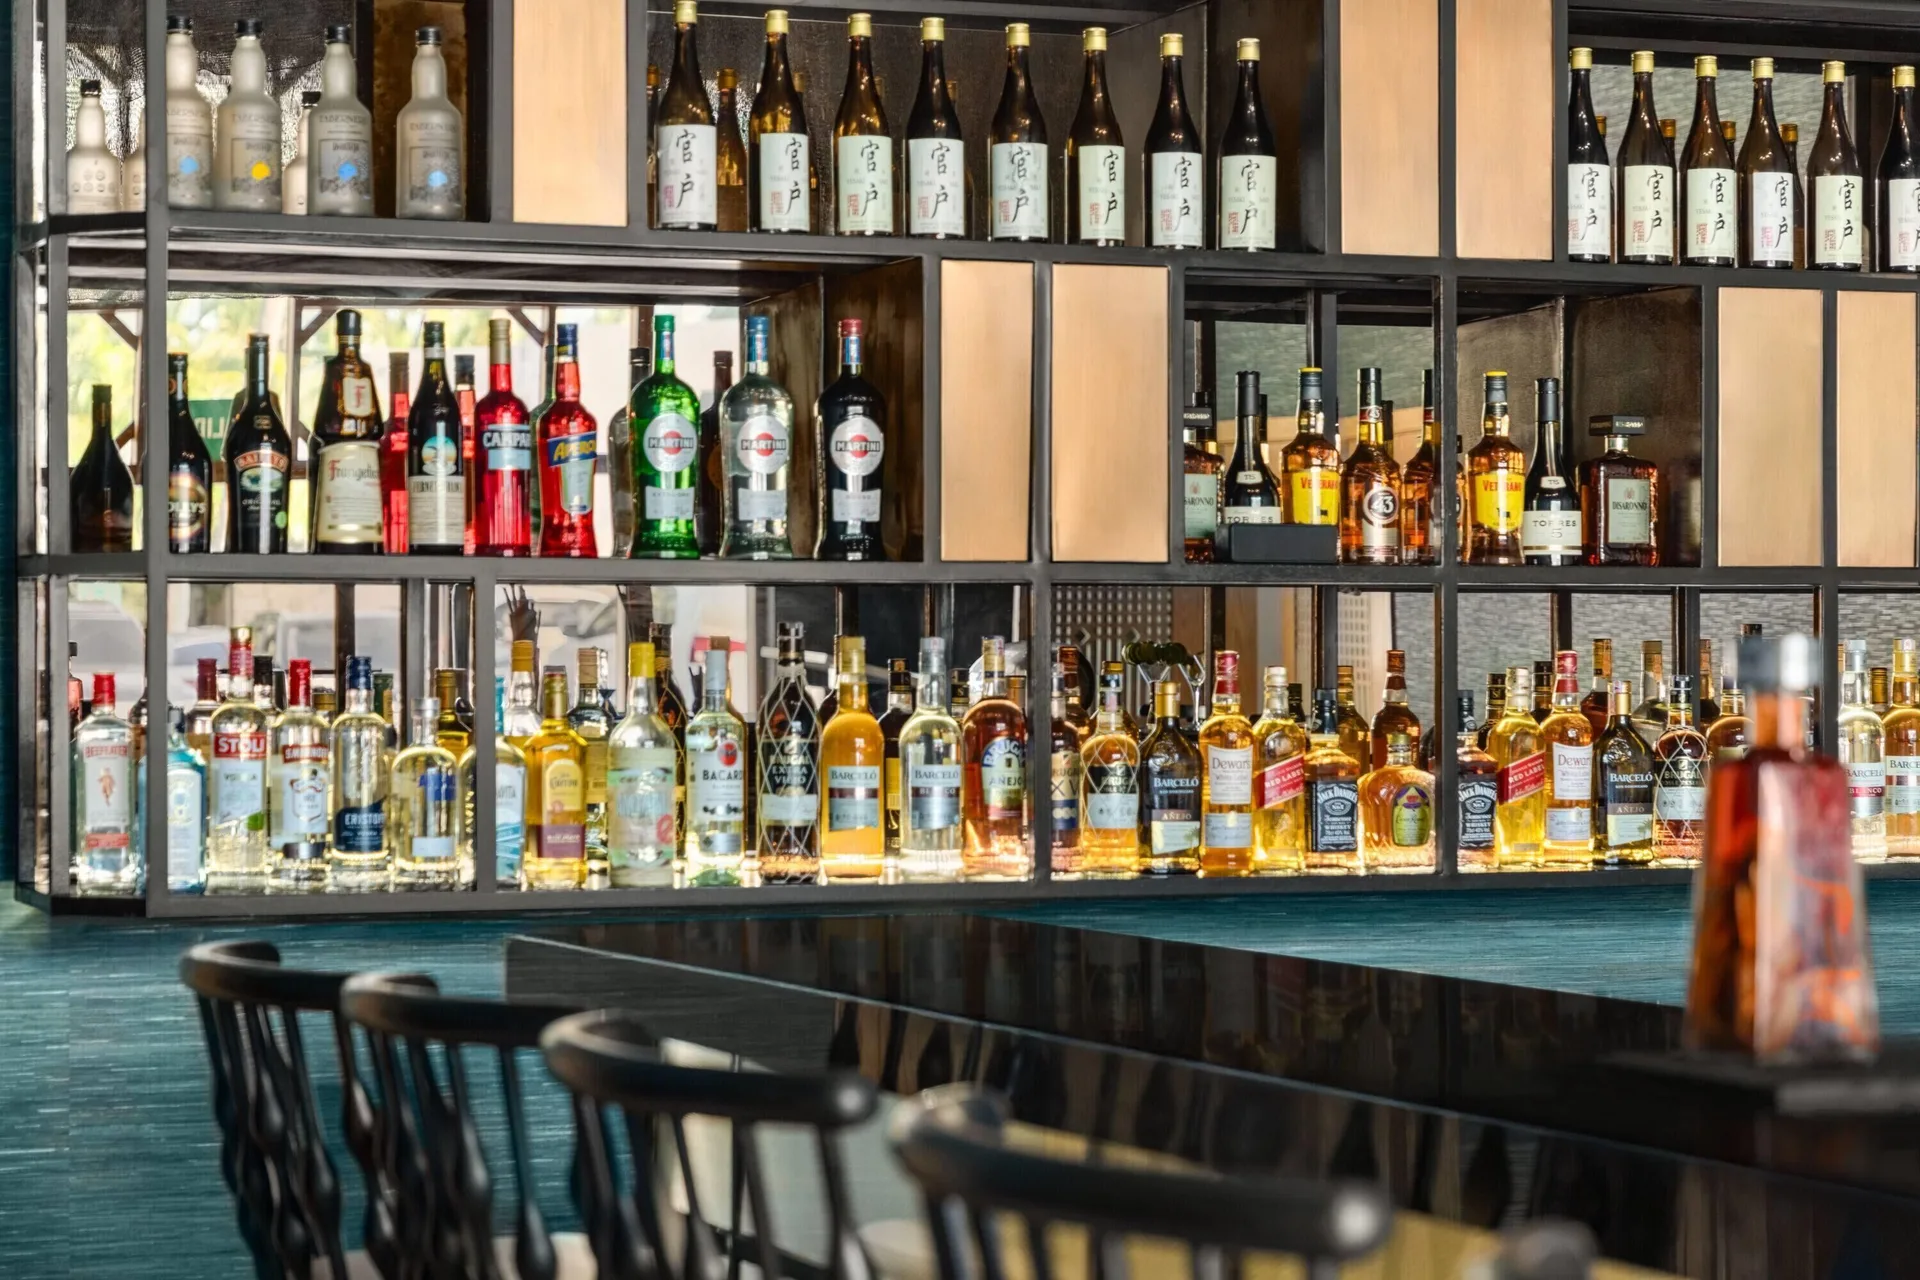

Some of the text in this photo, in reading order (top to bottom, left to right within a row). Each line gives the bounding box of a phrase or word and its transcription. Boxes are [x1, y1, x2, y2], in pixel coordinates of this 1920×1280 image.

[650, 438, 693, 448] MARTINI
[742, 440, 785, 450] MARTINI
[837, 441, 880, 451] MARTINI
[238, 452, 287, 468] BAIYS
[1482, 480, 1523, 491] VETRANO
[242, 499, 281, 507] ORIGAL
[1372, 496, 1394, 513] 43
[1612, 501, 1648, 510] DISARONNO
[1227, 516, 1274, 524] TORES
[219, 738, 265, 753] STOLI
[285, 746, 330, 759] SMIOFF
[223, 773, 257, 781] VOA
[1508, 773, 1524, 784] RED
[1610, 772, 1653, 784] BARCELÓ
[1154, 777, 1199, 788] BARCELÓ
[920, 788, 956, 796] BLCO
[1458, 788, 1475, 802] JACK
[1616, 804, 1645, 813] AÑEJO
[1162, 811, 1191, 820] AÑEJO
